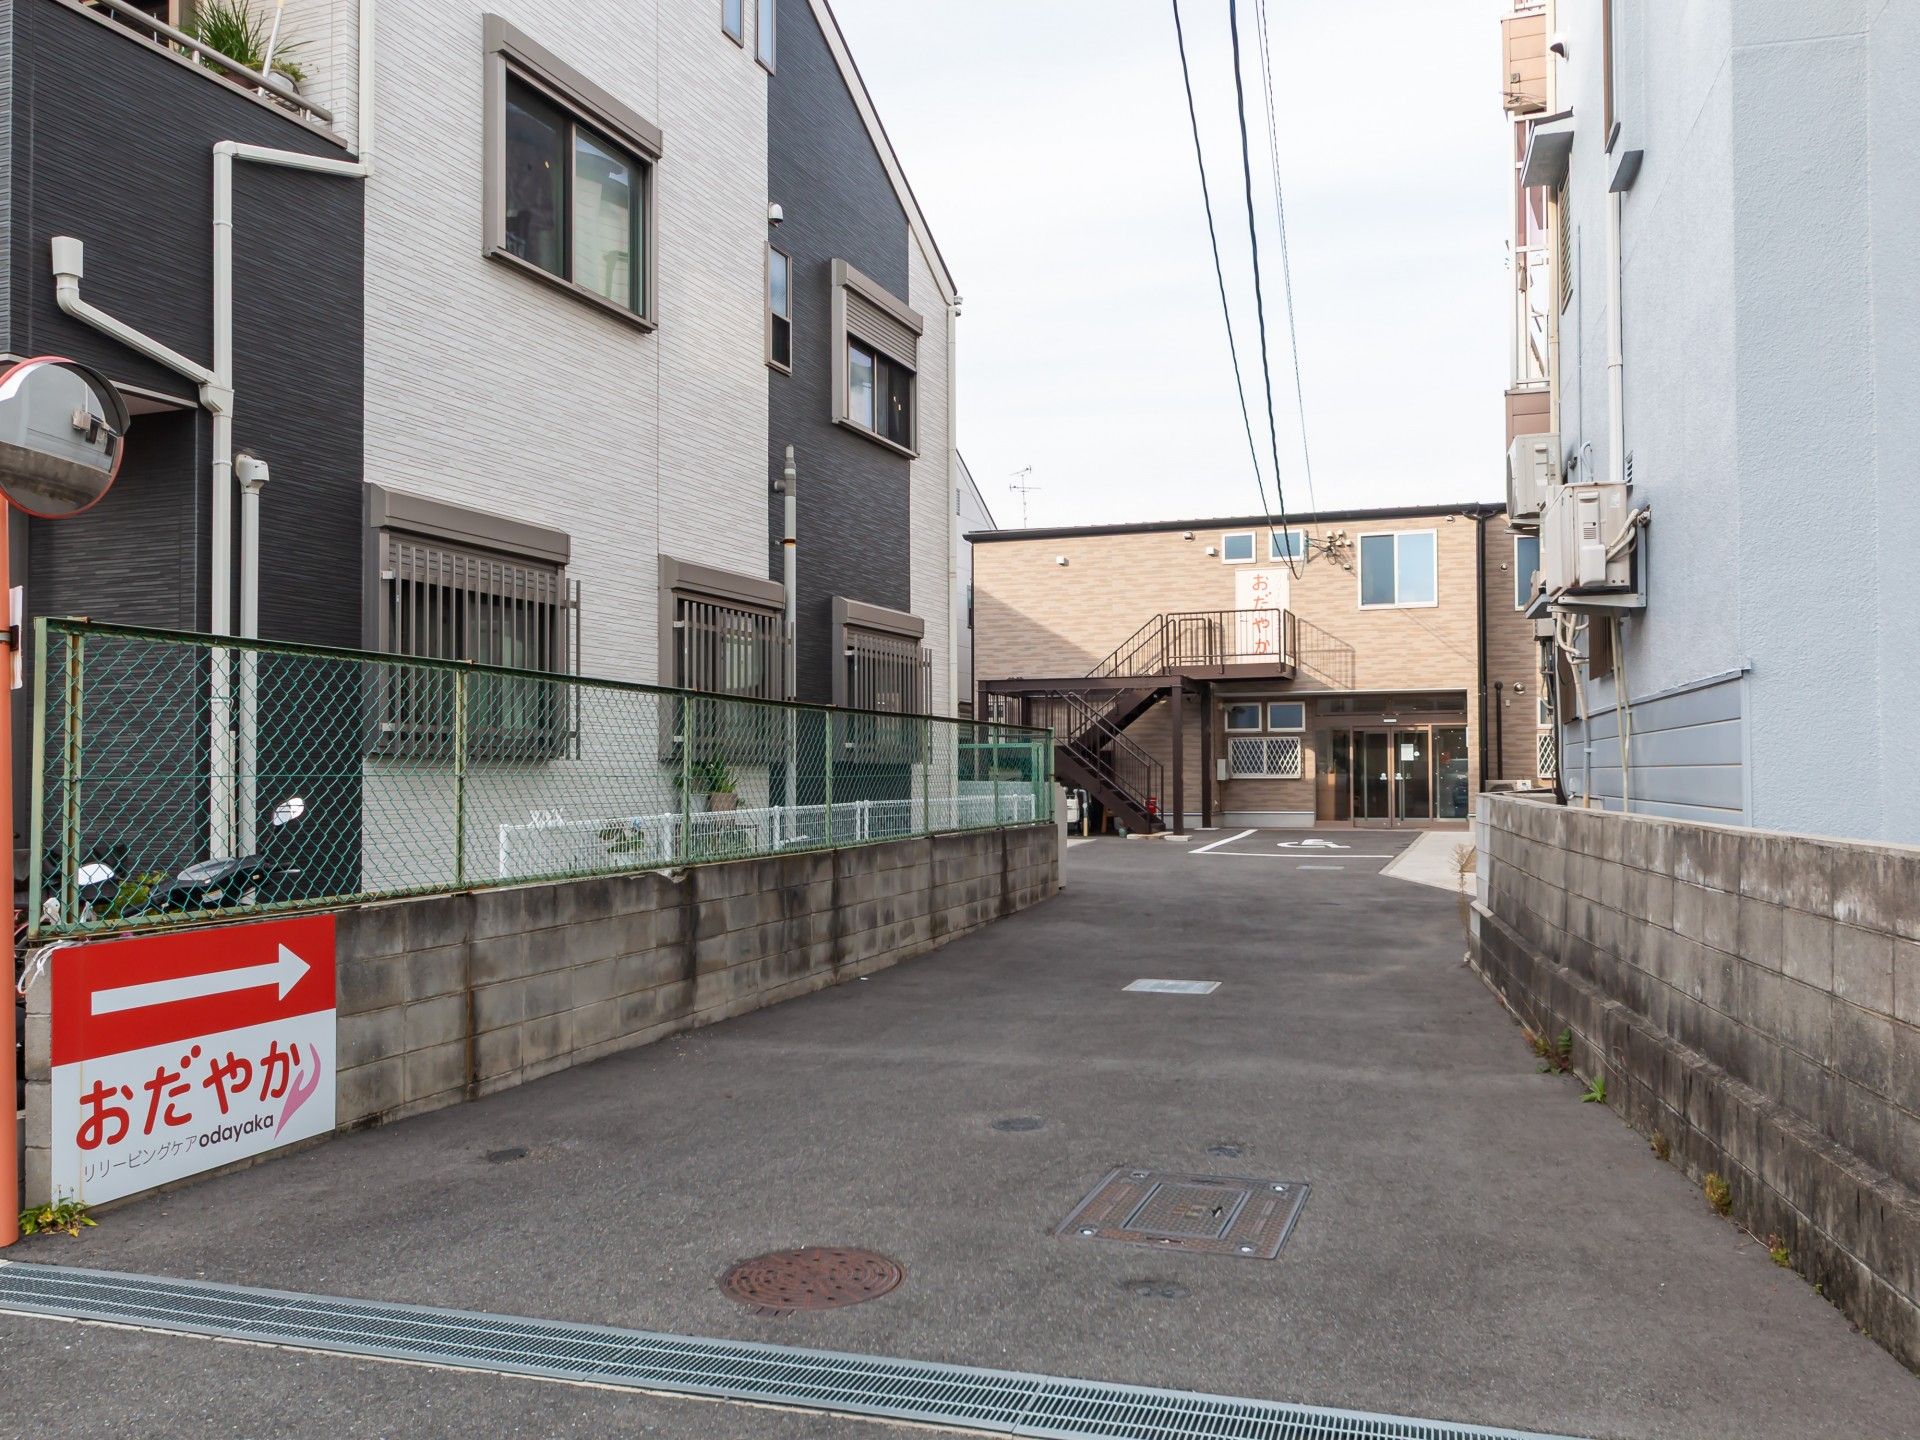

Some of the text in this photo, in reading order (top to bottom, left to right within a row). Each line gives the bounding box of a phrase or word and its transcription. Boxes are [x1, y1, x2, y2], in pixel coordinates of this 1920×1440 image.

[1252, 574, 1272, 654] おだやか
[76, 1041, 301, 1150] おだやか
[199, 1114, 274, 1148] odayaka
